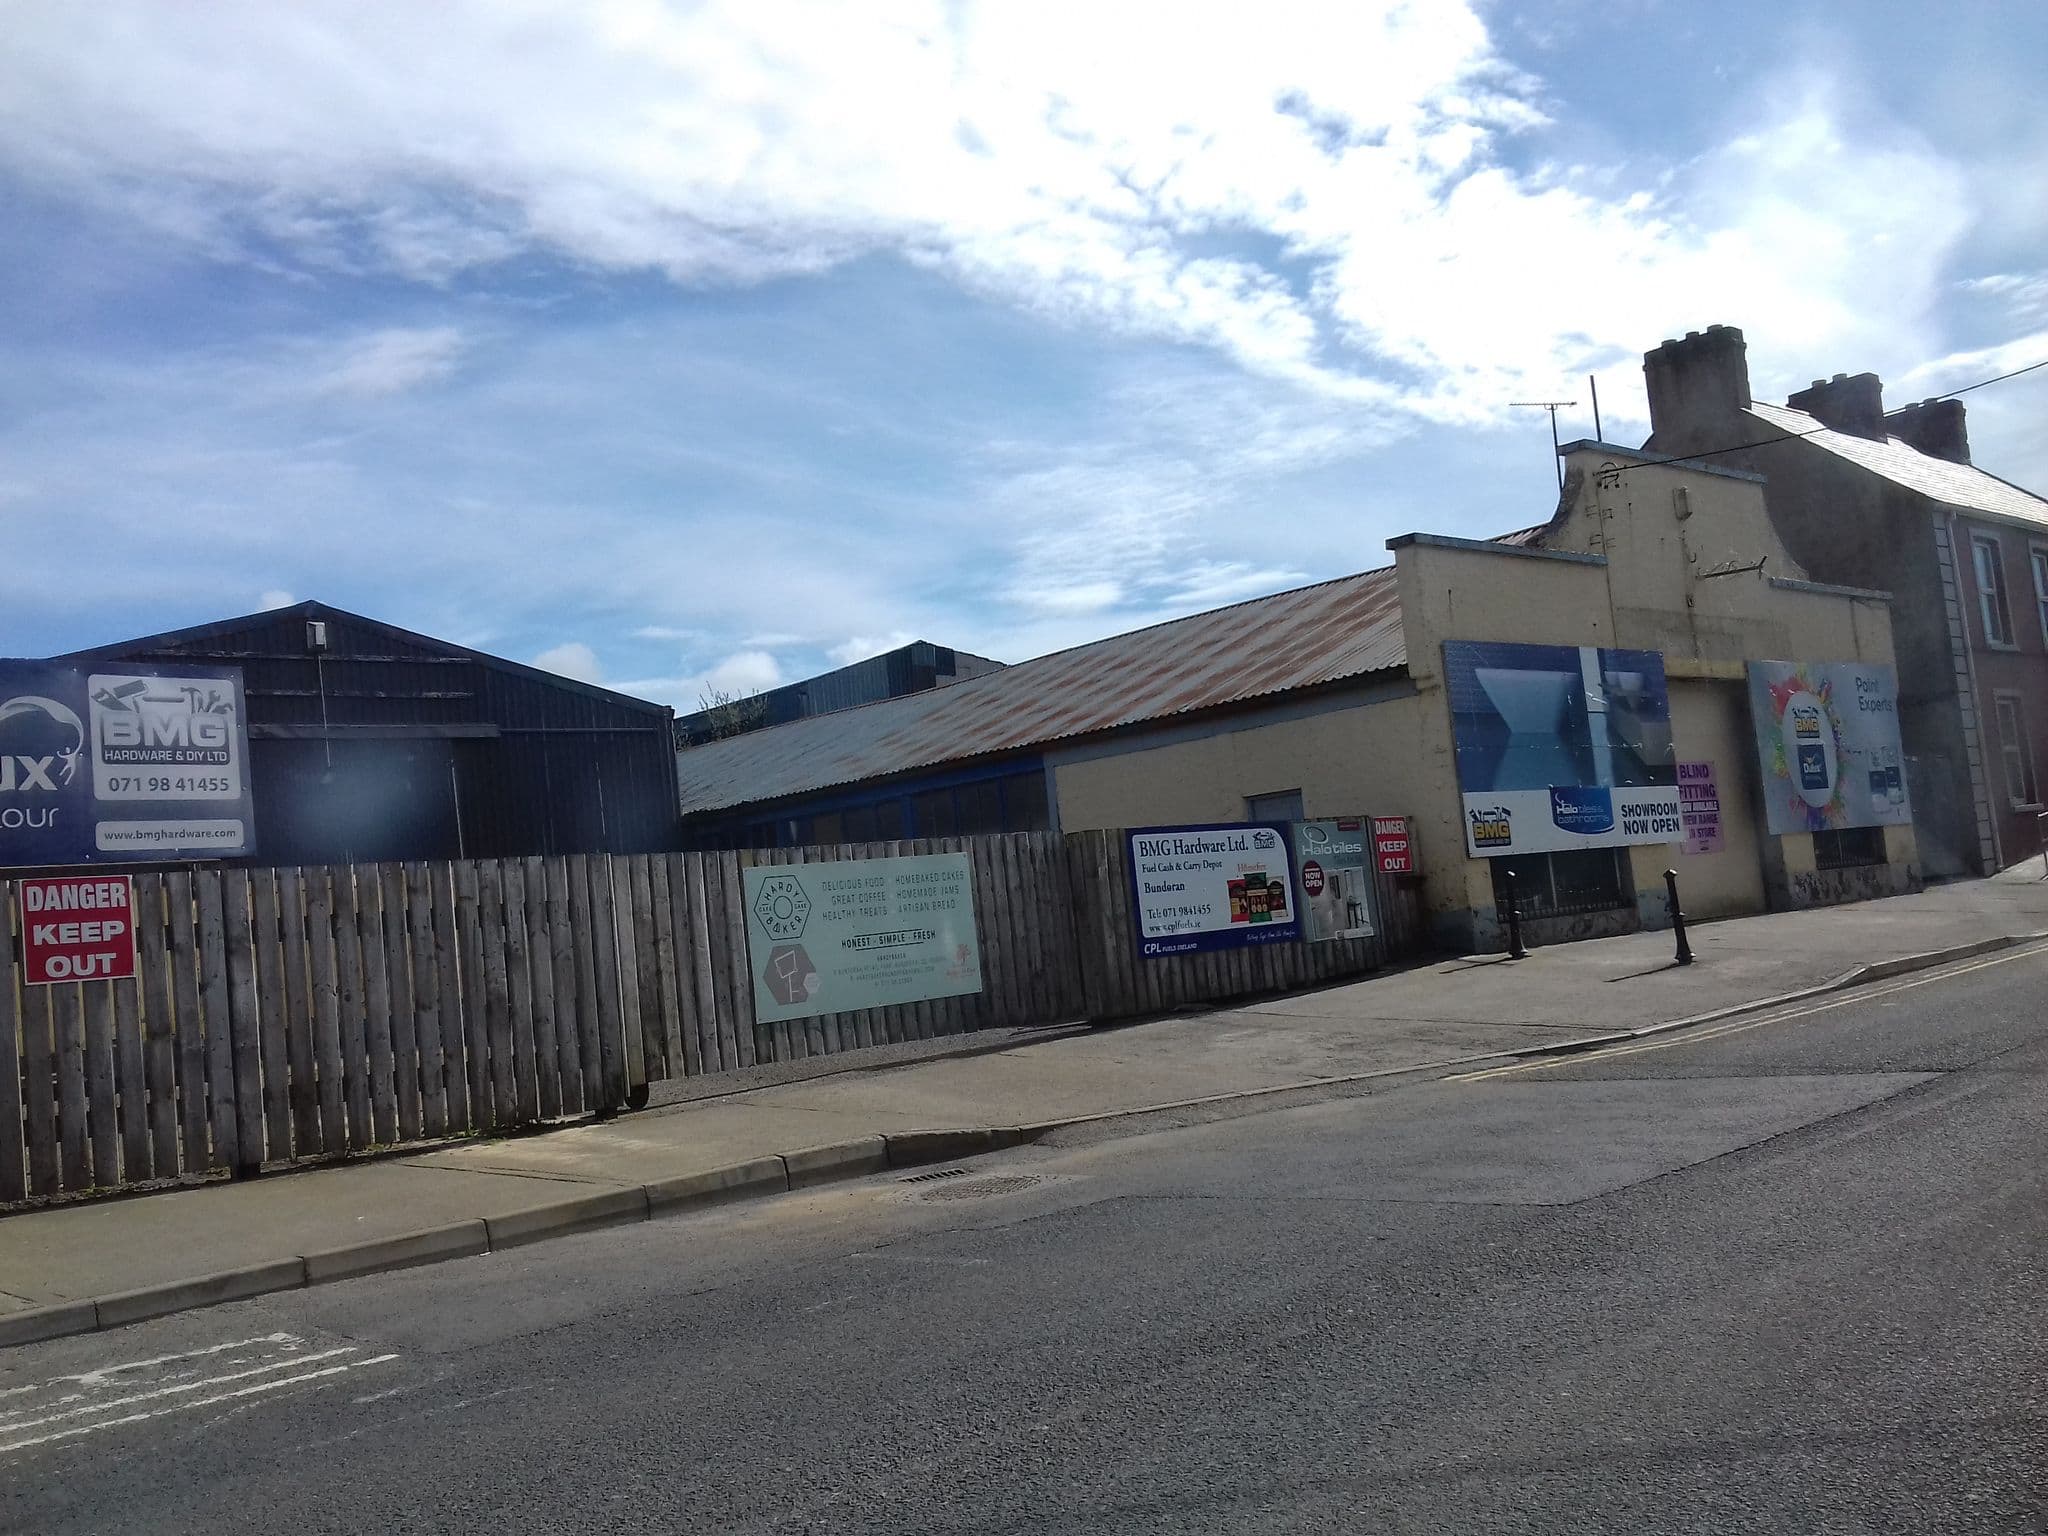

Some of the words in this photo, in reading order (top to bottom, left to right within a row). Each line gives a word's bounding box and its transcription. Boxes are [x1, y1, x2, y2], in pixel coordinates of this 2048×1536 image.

[103, 714, 227, 747] BMG
[104, 750, 172, 761] HARDWARE
[175, 751, 184, 761] &
[187, 751, 205, 761] DIY
[207, 751, 227, 762] LTD
[1679, 764, 1709, 779] BLIND
[108, 777, 141, 792] 071
[148, 777, 170, 792] 98
[175, 777, 229, 792] 41455
[1621, 802, 1678, 817] SHOWROOM
[0, 808, 60, 828] our
[1375, 820, 1406, 835] DANGER
[1474, 822, 1510, 839] BMG
[1623, 820, 1648, 835] NOW
[1651, 818, 1680, 833] OPEN
[104, 829, 236, 842] www.bmghardware.com
[1139, 840, 1171, 858] BMG
[1172, 836, 1227, 856] Hardware
[1378, 840, 1407, 852] KEEP
[1141, 863, 1157, 874] Fuel
[1158, 861, 1174, 872] Cash
[1175, 861, 1182, 871] &
[1183, 860, 1201, 873] Carry
[1384, 857, 1406, 870] OUT
[1304, 871, 1321, 880] NOW
[764, 881, 800, 901] HARDY
[822, 878, 862, 892] DELICIOUS
[1304, 879, 1322, 889] OPEN
[26, 882, 127, 912] DANGER
[831, 894, 855, 906] GREAT
[858, 891, 887, 904] COFFEE
[896, 886, 937, 899] HOMEMADE
[822, 908, 857, 922] HEALTHY
[859, 906, 888, 919] TREATS
[1162, 906, 1177, 918] 071
[33, 920, 125, 946] KEEP
[841, 937, 871, 949] HONEST
[879, 933, 906, 945] SIMPLE
[913, 929, 936, 941] FRESH
[1144, 942, 1161, 954] CPL
[45, 953, 116, 978] OUT
